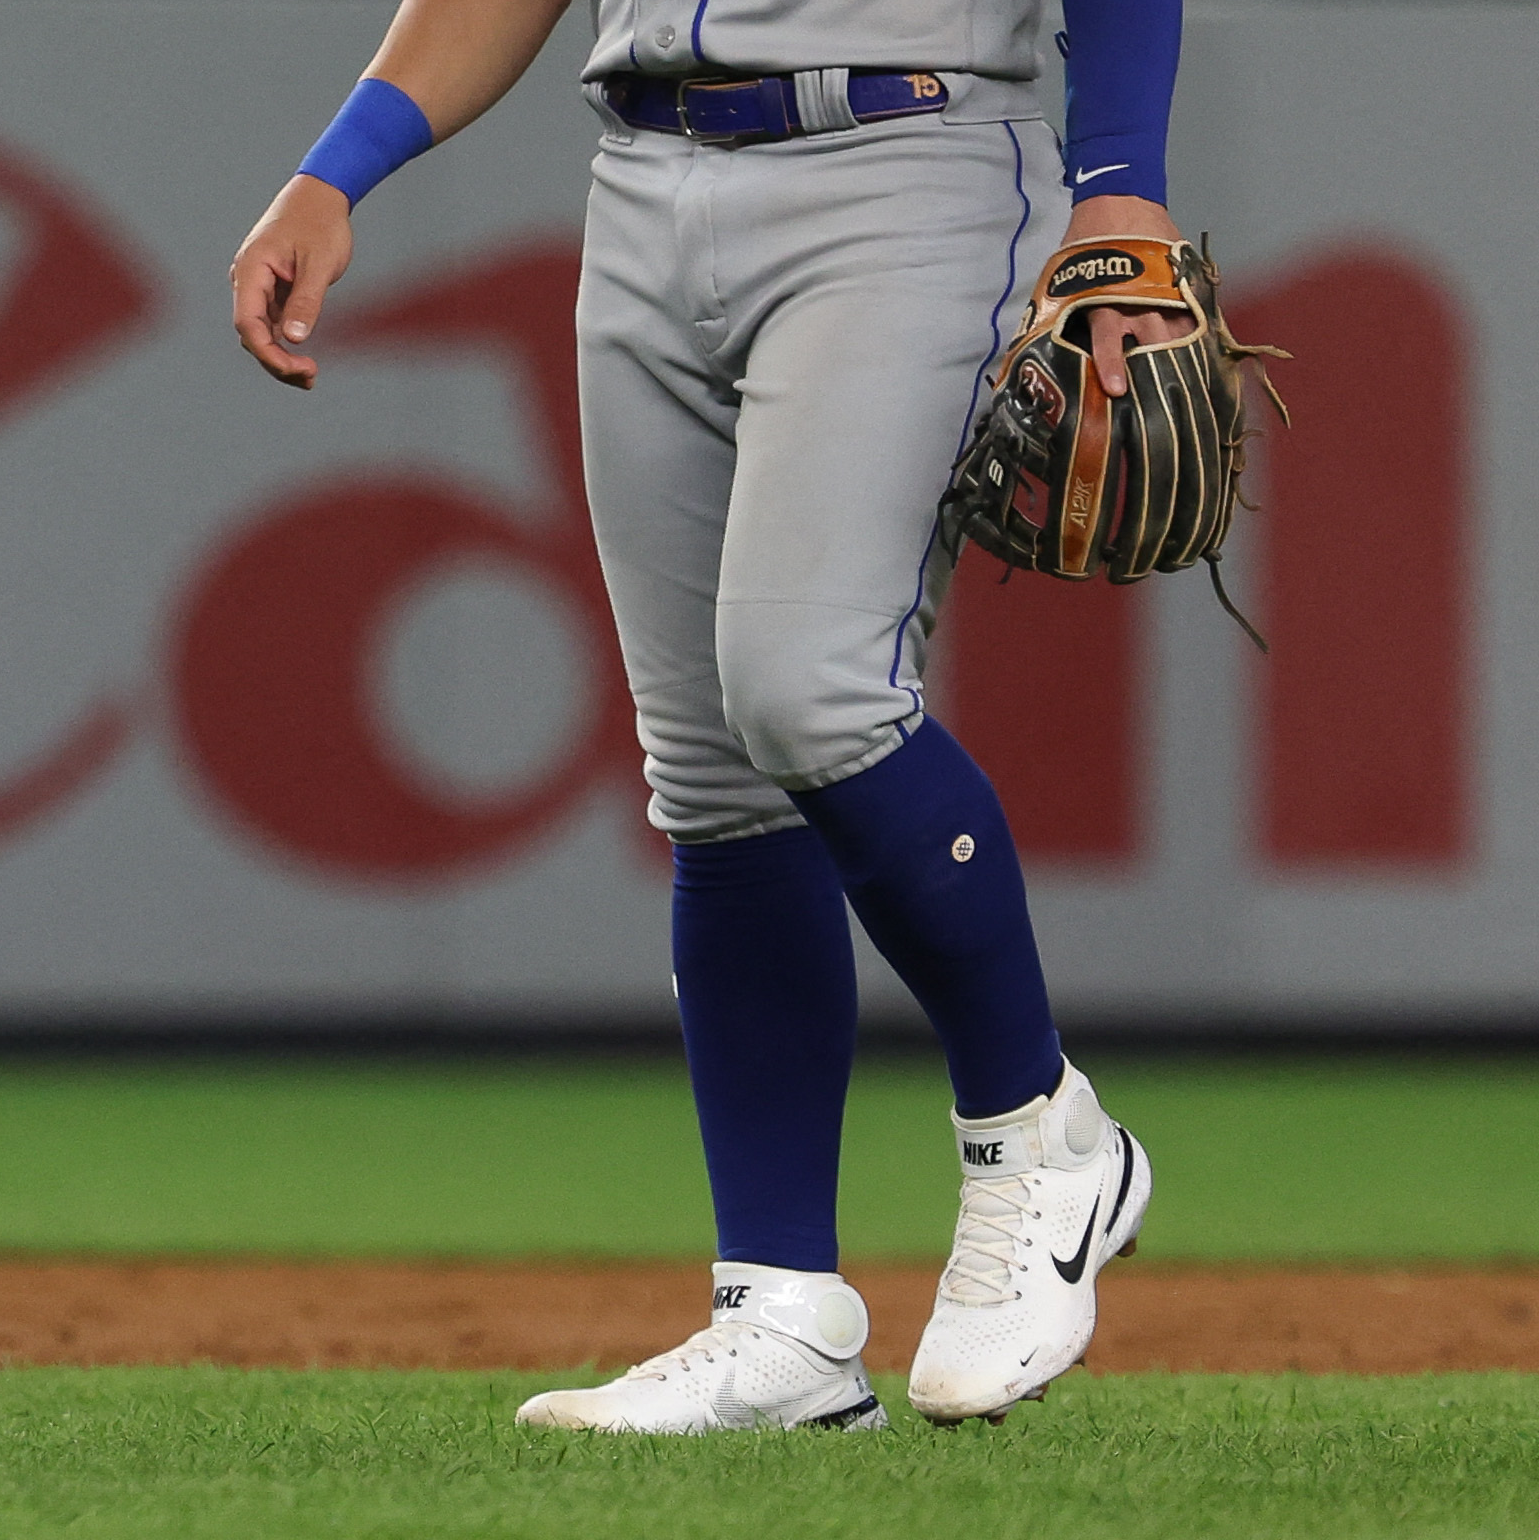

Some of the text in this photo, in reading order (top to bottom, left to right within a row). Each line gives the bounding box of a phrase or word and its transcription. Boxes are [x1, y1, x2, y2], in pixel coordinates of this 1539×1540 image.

[1053, 256, 1135, 286] Wilson
[1070, 475, 1095, 530] A2K
[963, 1141, 1004, 1166] NIKE
